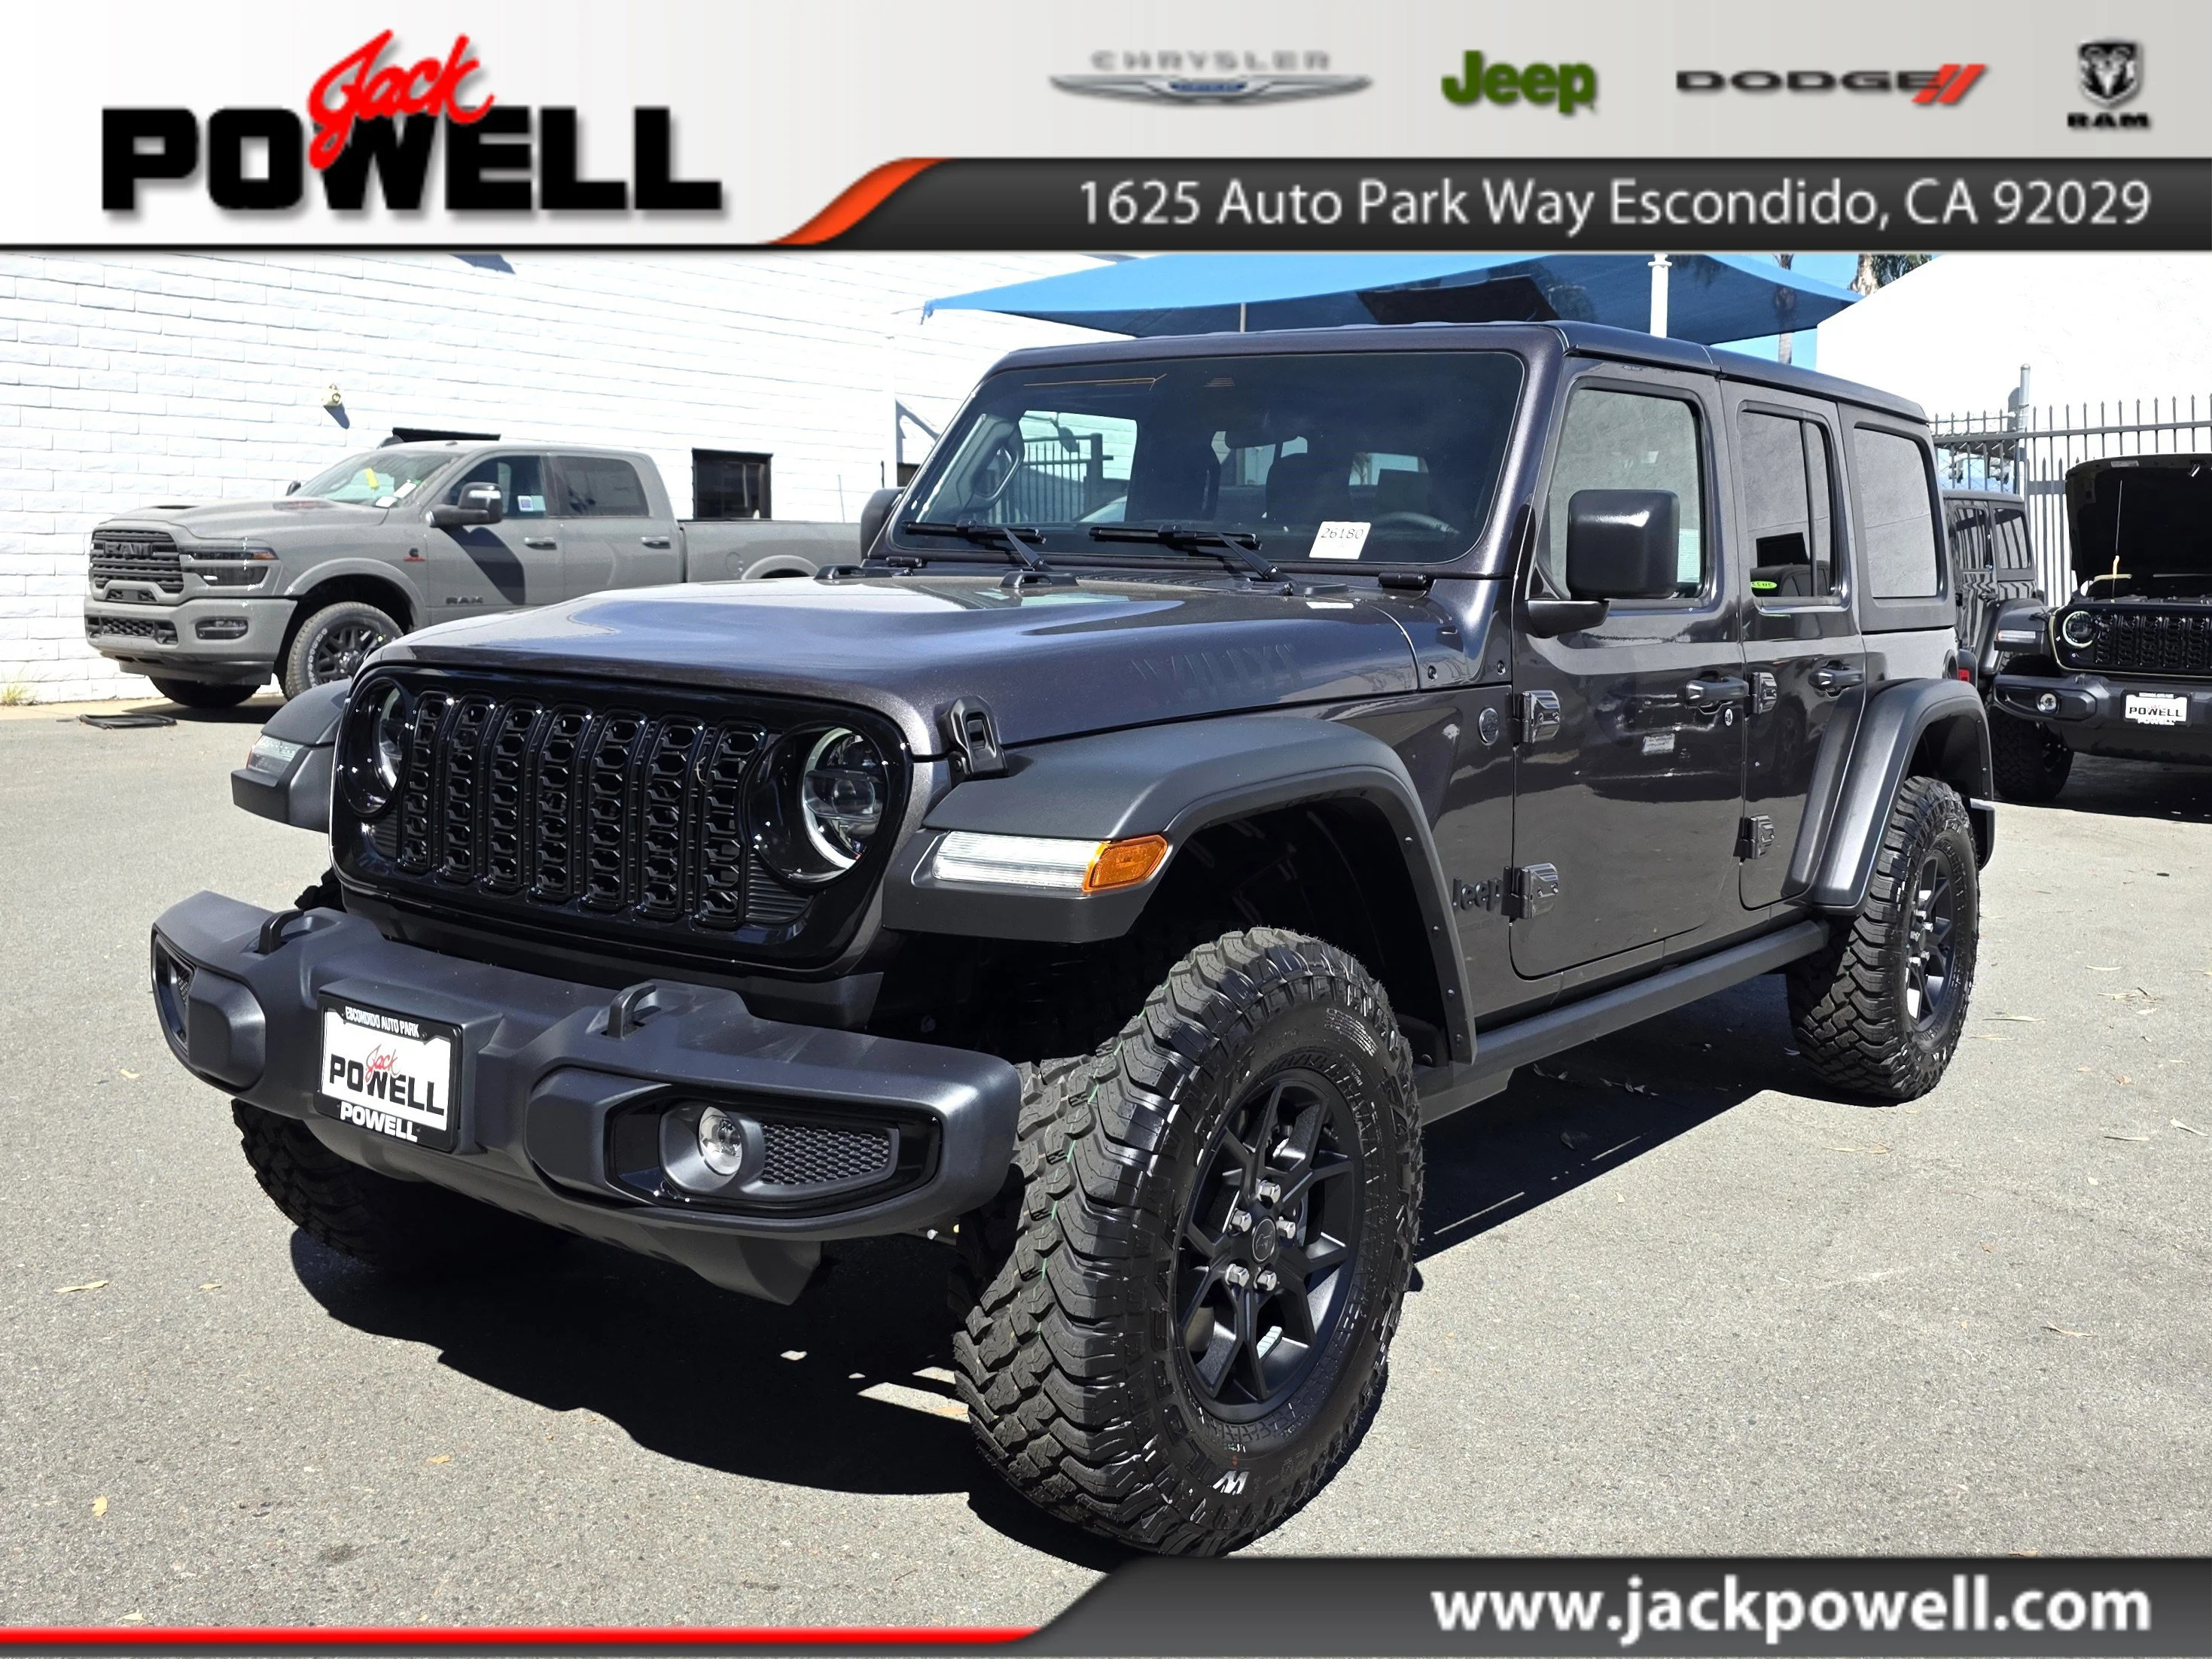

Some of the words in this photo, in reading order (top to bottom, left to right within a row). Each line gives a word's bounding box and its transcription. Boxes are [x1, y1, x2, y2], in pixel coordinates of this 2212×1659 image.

[103, 542, 152, 556] RAM
[1320, 527, 1364, 540] 26180
[445, 596, 483, 604] RAM
[2128, 706, 2183, 717] POWELL
[1452, 877, 1504, 912] Jeep
[345, 1006, 381, 1030] ESCONDIDO
[381, 1016, 399, 1033] AUTO
[400, 1021, 420, 1038] PARK
[365, 1043, 401, 1083] Jack
[329, 1053, 445, 1116] POWELL
[340, 1100, 418, 1143] POWELL
